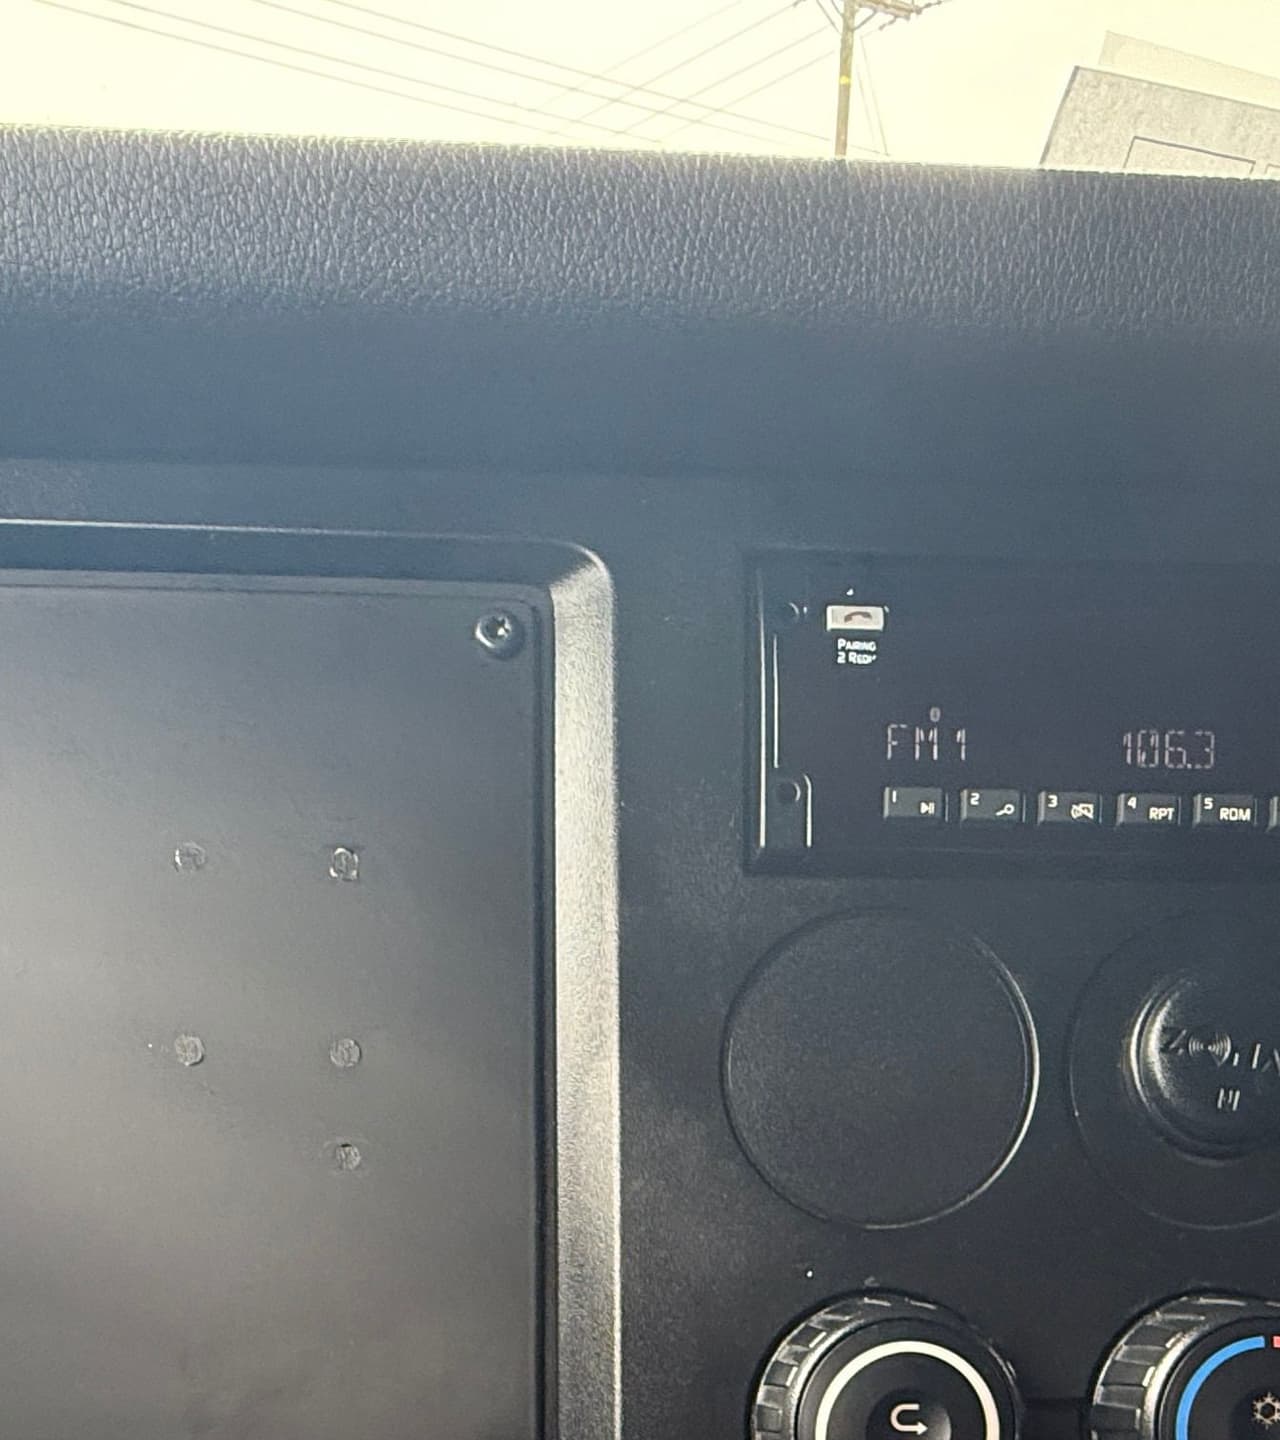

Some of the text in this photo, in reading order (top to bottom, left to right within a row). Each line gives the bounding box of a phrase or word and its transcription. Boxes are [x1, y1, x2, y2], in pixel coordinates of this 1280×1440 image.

[1123, 729, 1215, 769] 106.3
[970, 793, 980, 805] 2
[1048, 795, 1058, 808] 3
[1127, 796, 1137, 809] 4
[1203, 797, 1213, 810] 5
[1149, 807, 1175, 821] RPT
[1220, 808, 1251, 822] RDM
